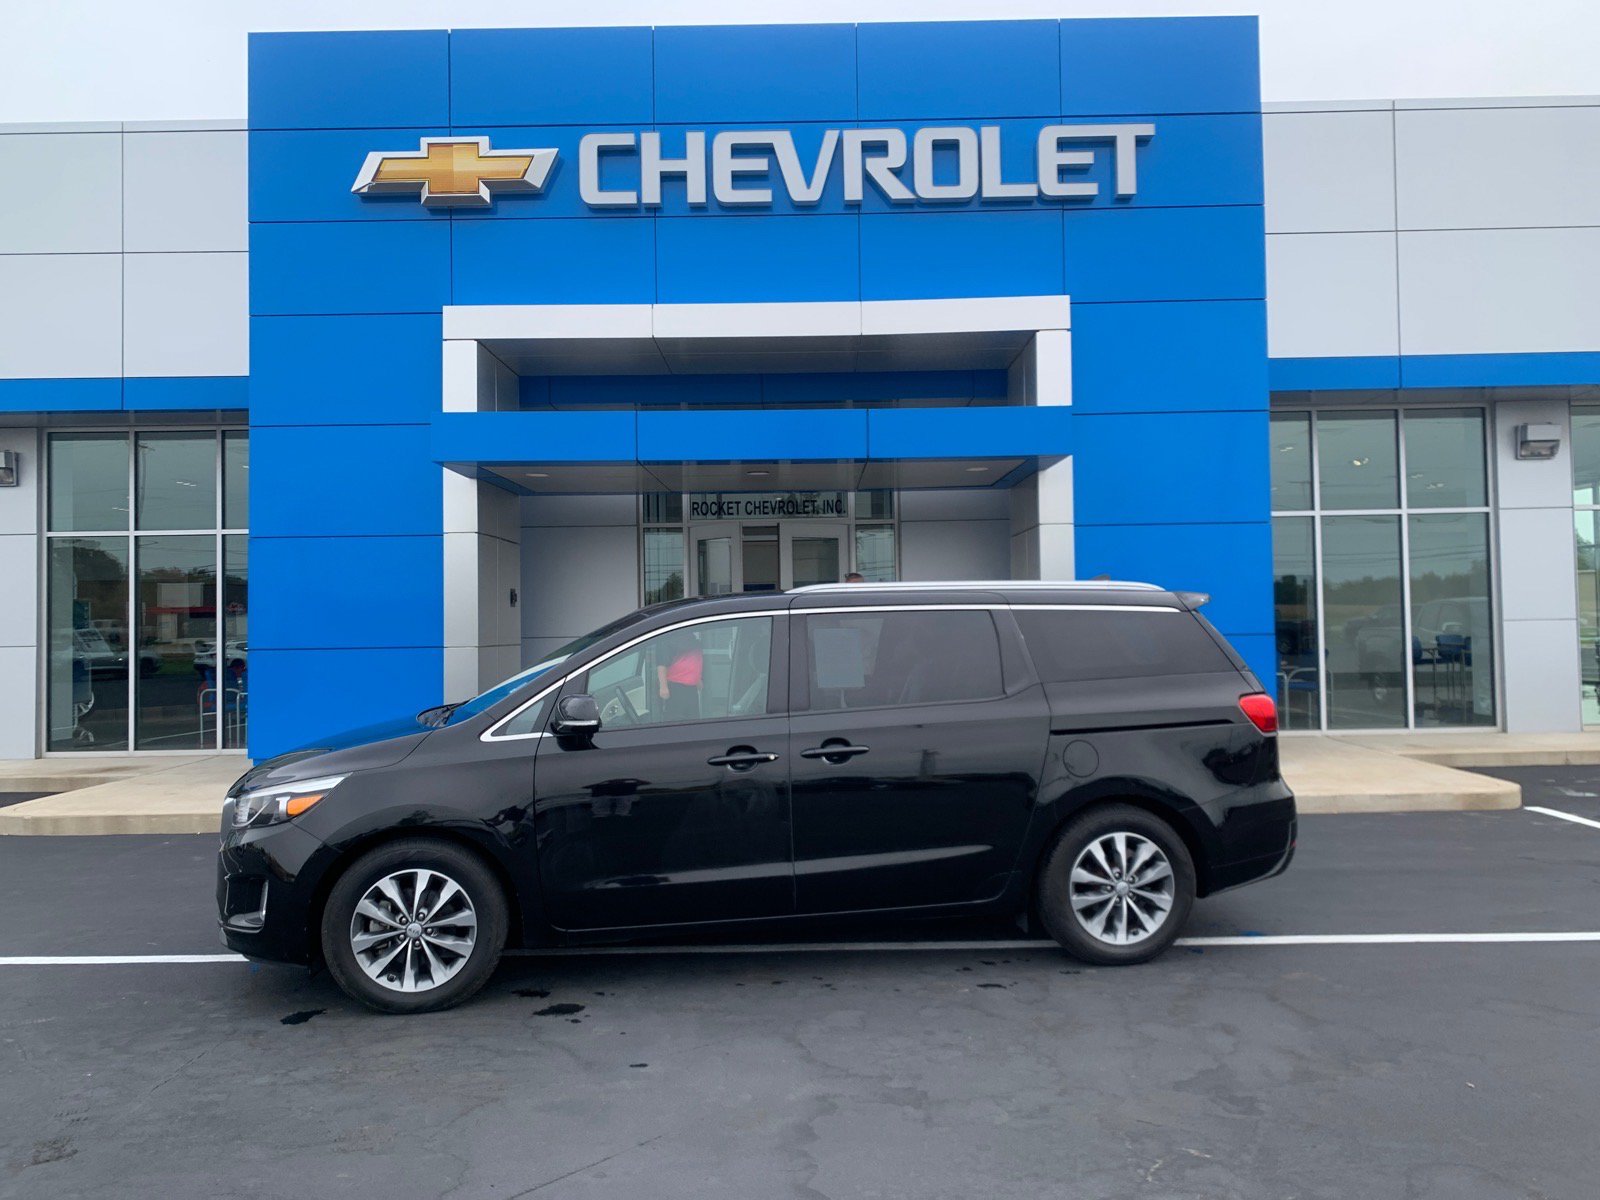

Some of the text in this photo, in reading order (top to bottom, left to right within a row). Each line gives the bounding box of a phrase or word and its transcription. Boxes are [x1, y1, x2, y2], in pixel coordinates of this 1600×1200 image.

[579, 123, 1156, 207] CHEVROLET
[692, 501, 741, 516] ROCKET
[823, 499, 846, 514] INC.
